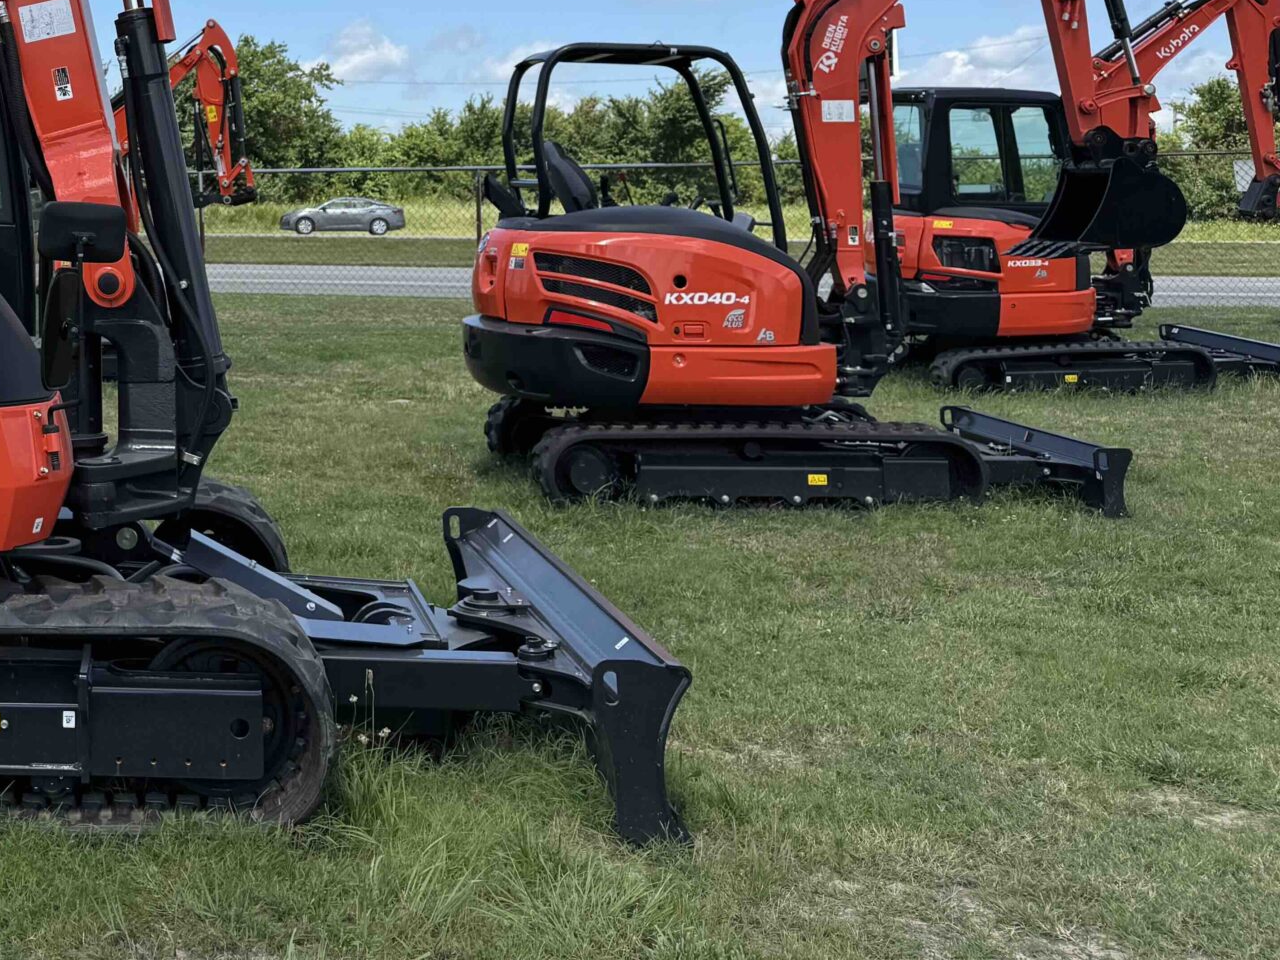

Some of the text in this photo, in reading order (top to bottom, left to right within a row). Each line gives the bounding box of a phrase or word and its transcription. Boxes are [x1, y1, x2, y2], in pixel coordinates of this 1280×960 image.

[821, 23, 837, 49] DEEN
[830, 15, 849, 52] KUBOTA
[1155, 24, 1200, 59] Kubota
[664, 291, 750, 305] KX040-4
[757, 328, 775, 341] AB
